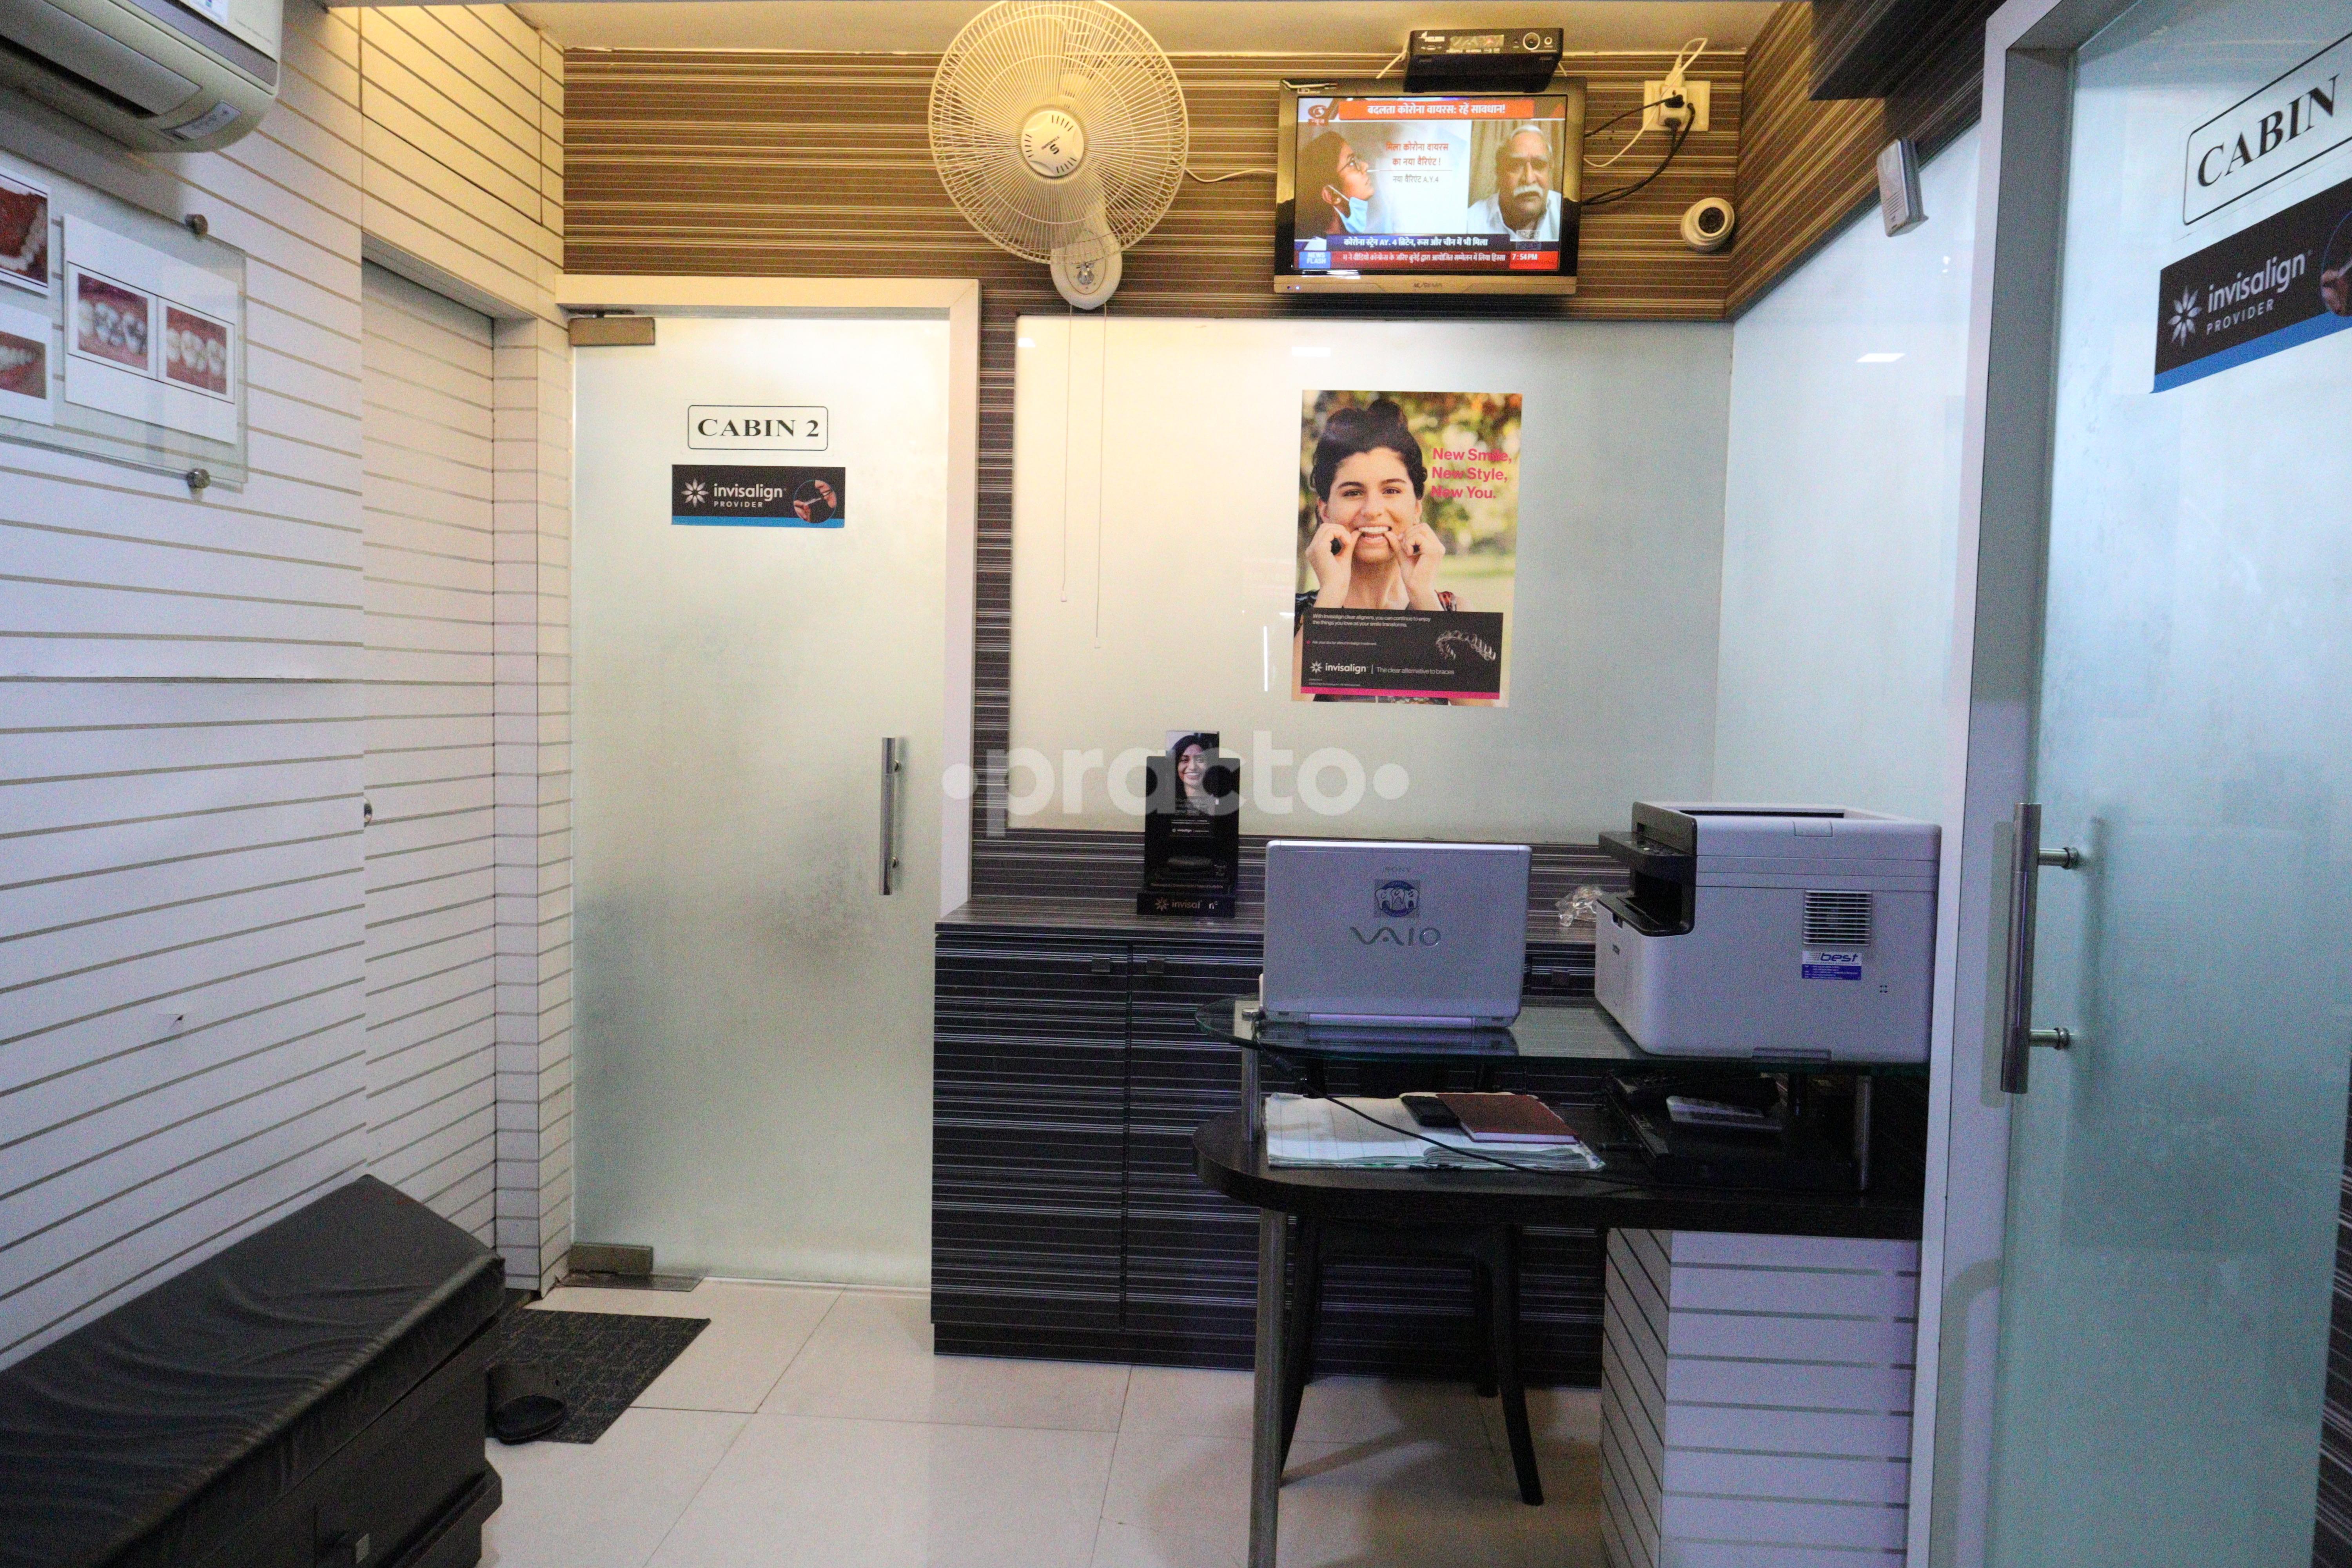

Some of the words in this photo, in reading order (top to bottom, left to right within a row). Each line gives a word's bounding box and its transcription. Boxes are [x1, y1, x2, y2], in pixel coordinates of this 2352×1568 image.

[1367, 105, 1396, 114] बदलता
[1397, 102, 1425, 114] कोरोना
[1426, 105, 1457, 113] वायरस:
[2197, 74, 2339, 187] CABIN
[1386, 142, 1401, 151] मिला
[1403, 141, 1425, 151] कोरोना
[1344, 237, 1365, 246] कोरोना
[1430, 236, 1442, 245] और
[1443, 237, 1455, 245] चीन
[1463, 236, 1472, 245] भी
[1473, 237, 1488, 246] मिला
[2207, 253, 2307, 312] invisalign
[2206, 298, 2274, 335] PROVIDER
[697, 419, 795, 437] CABIN
[806, 420, 819, 437] 2
[1433, 448, 1465, 460] New
[1432, 466, 1465, 479] New
[1467, 467, 1508, 482] Style,
[713, 483, 783, 501] invisalign
[1430, 485, 1463, 497] New
[1466, 486, 1496, 498] You.
[1325, 663, 1366, 674] invisalign
[1350, 926, 1441, 948] VAIO
